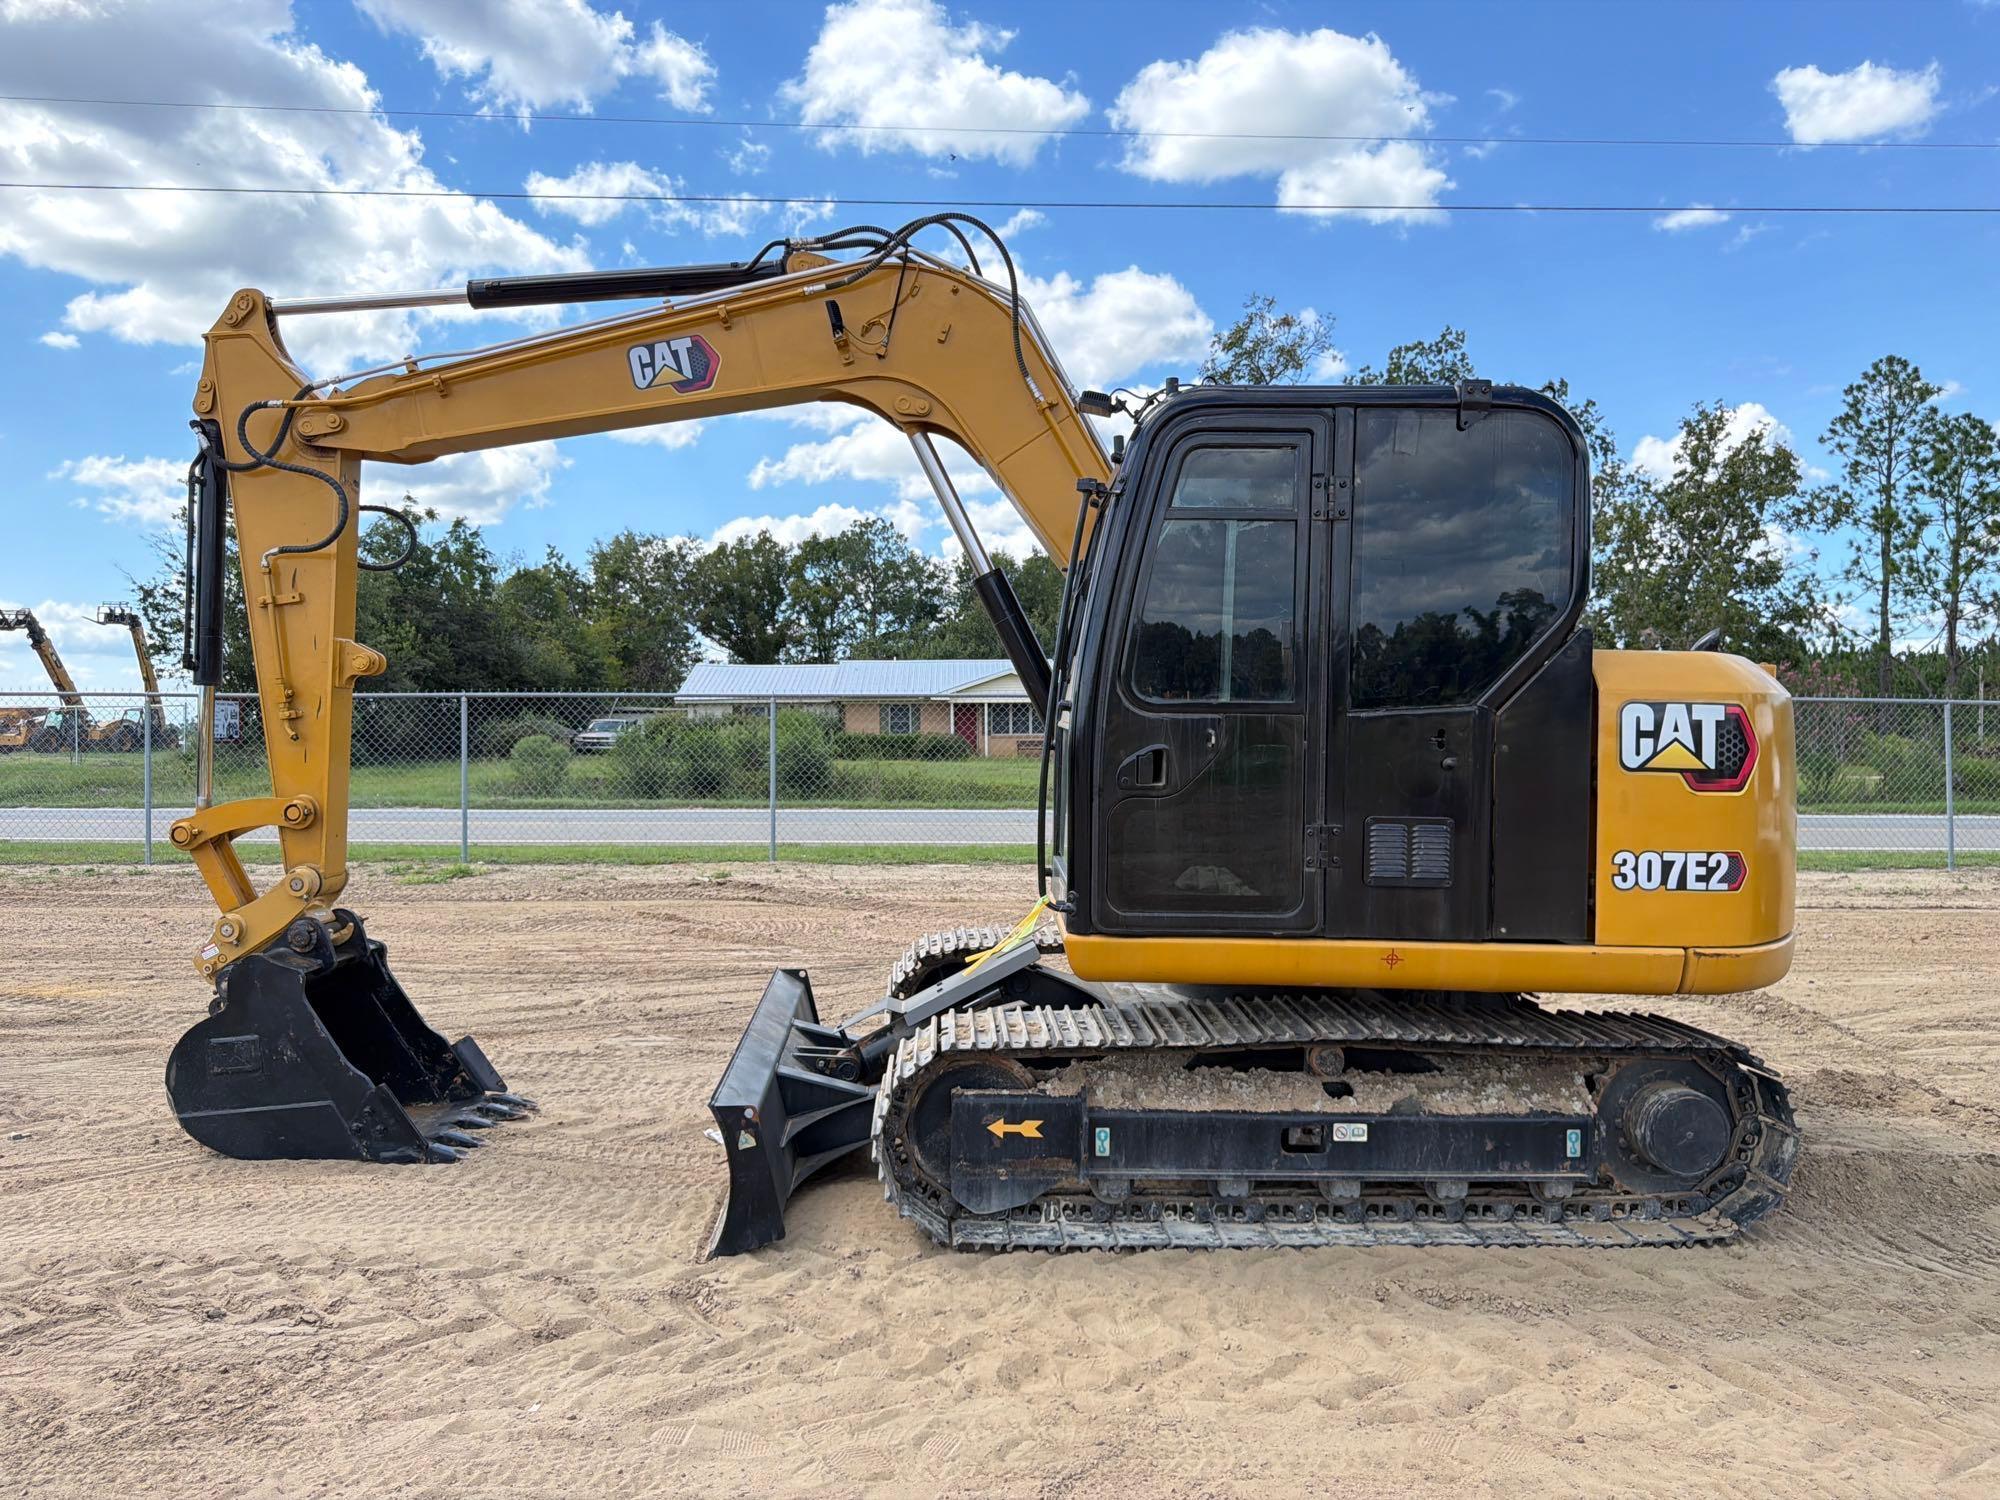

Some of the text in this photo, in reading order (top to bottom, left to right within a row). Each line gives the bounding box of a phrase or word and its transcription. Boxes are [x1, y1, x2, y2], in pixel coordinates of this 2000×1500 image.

[629, 337, 693, 389] CAT
[1621, 703, 1725, 769] CAT
[1613, 851, 1729, 890] 307E2
